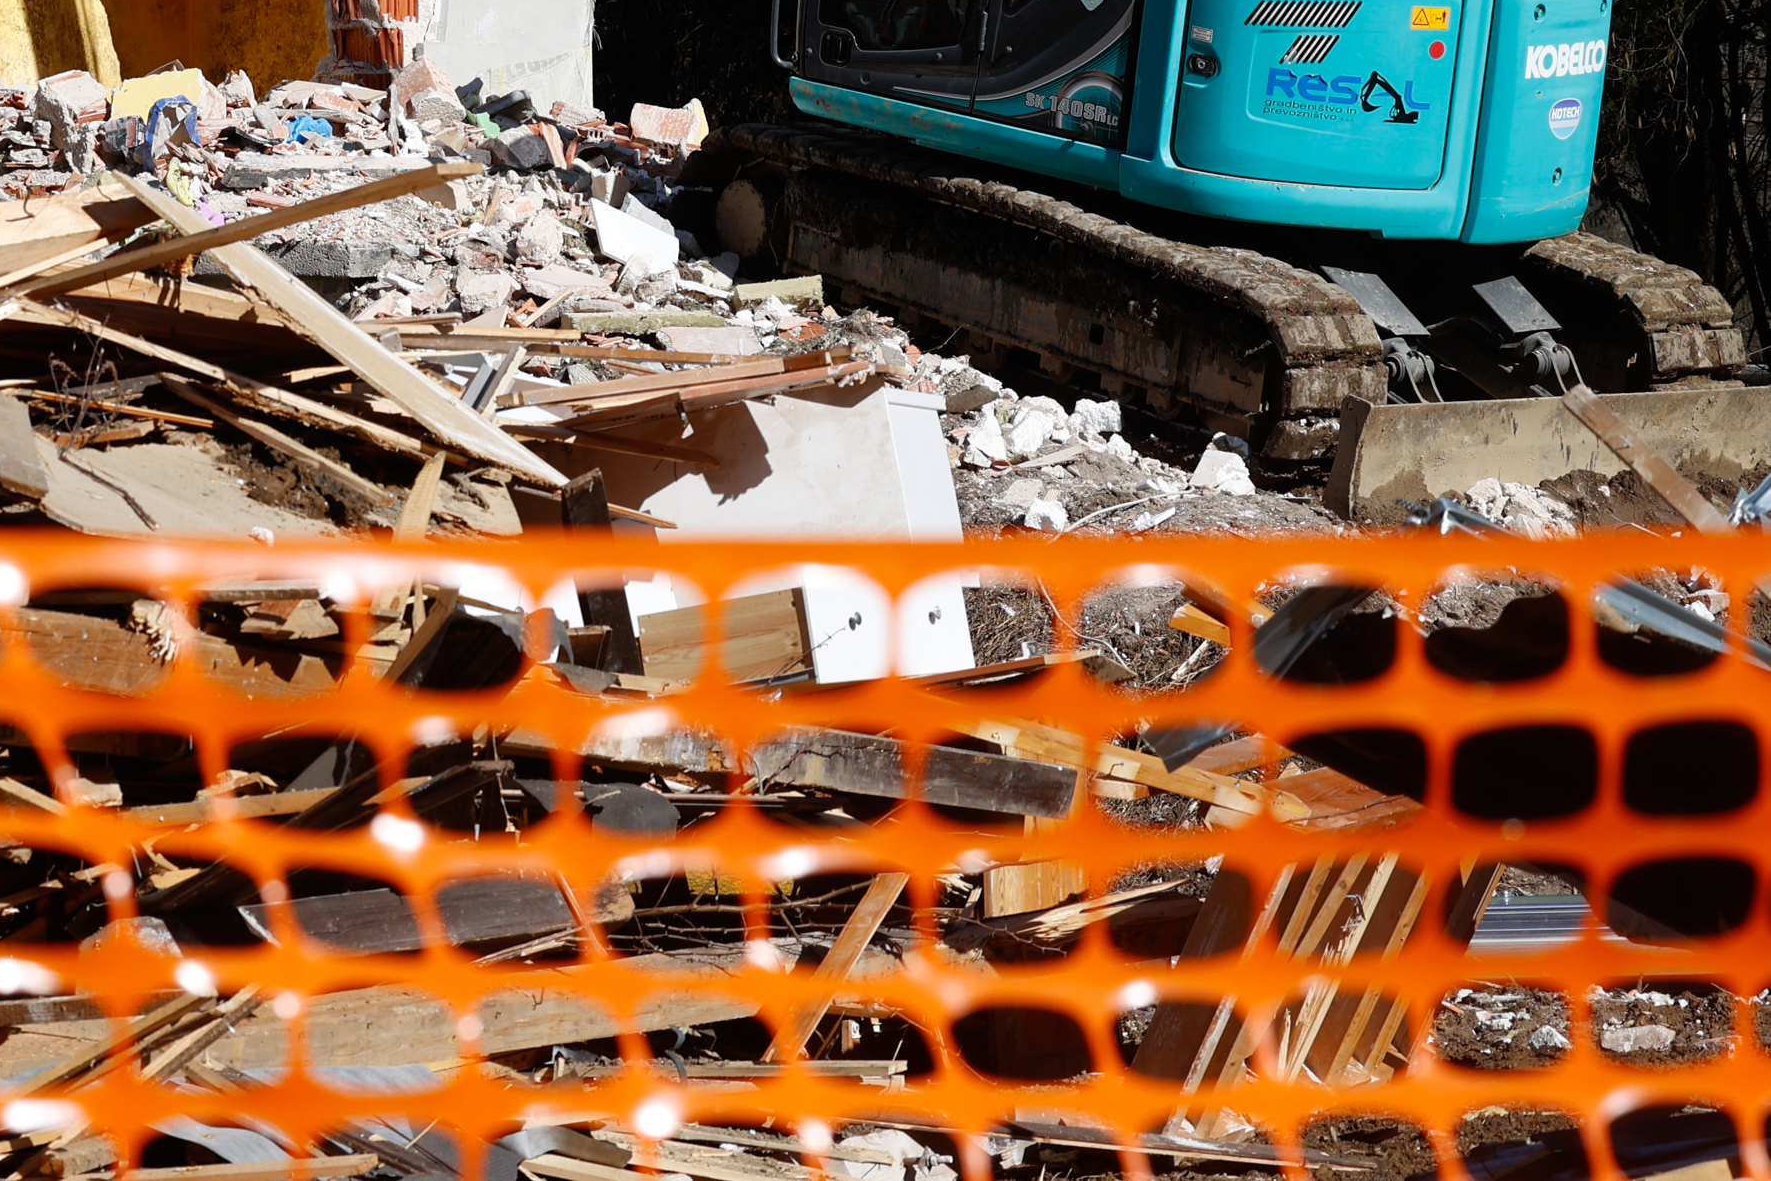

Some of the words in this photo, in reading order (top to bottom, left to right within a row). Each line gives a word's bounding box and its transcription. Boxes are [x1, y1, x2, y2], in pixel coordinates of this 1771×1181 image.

[1525, 39, 1605, 79] KOBELCO
[1025, 92, 1045, 109] SK
[1264, 99, 1343, 114] gradbeništvo
[1346, 107, 1357, 115] in
[1263, 106, 1337, 120] prevozništvo
[1552, 105, 1580, 119] KOTECH
